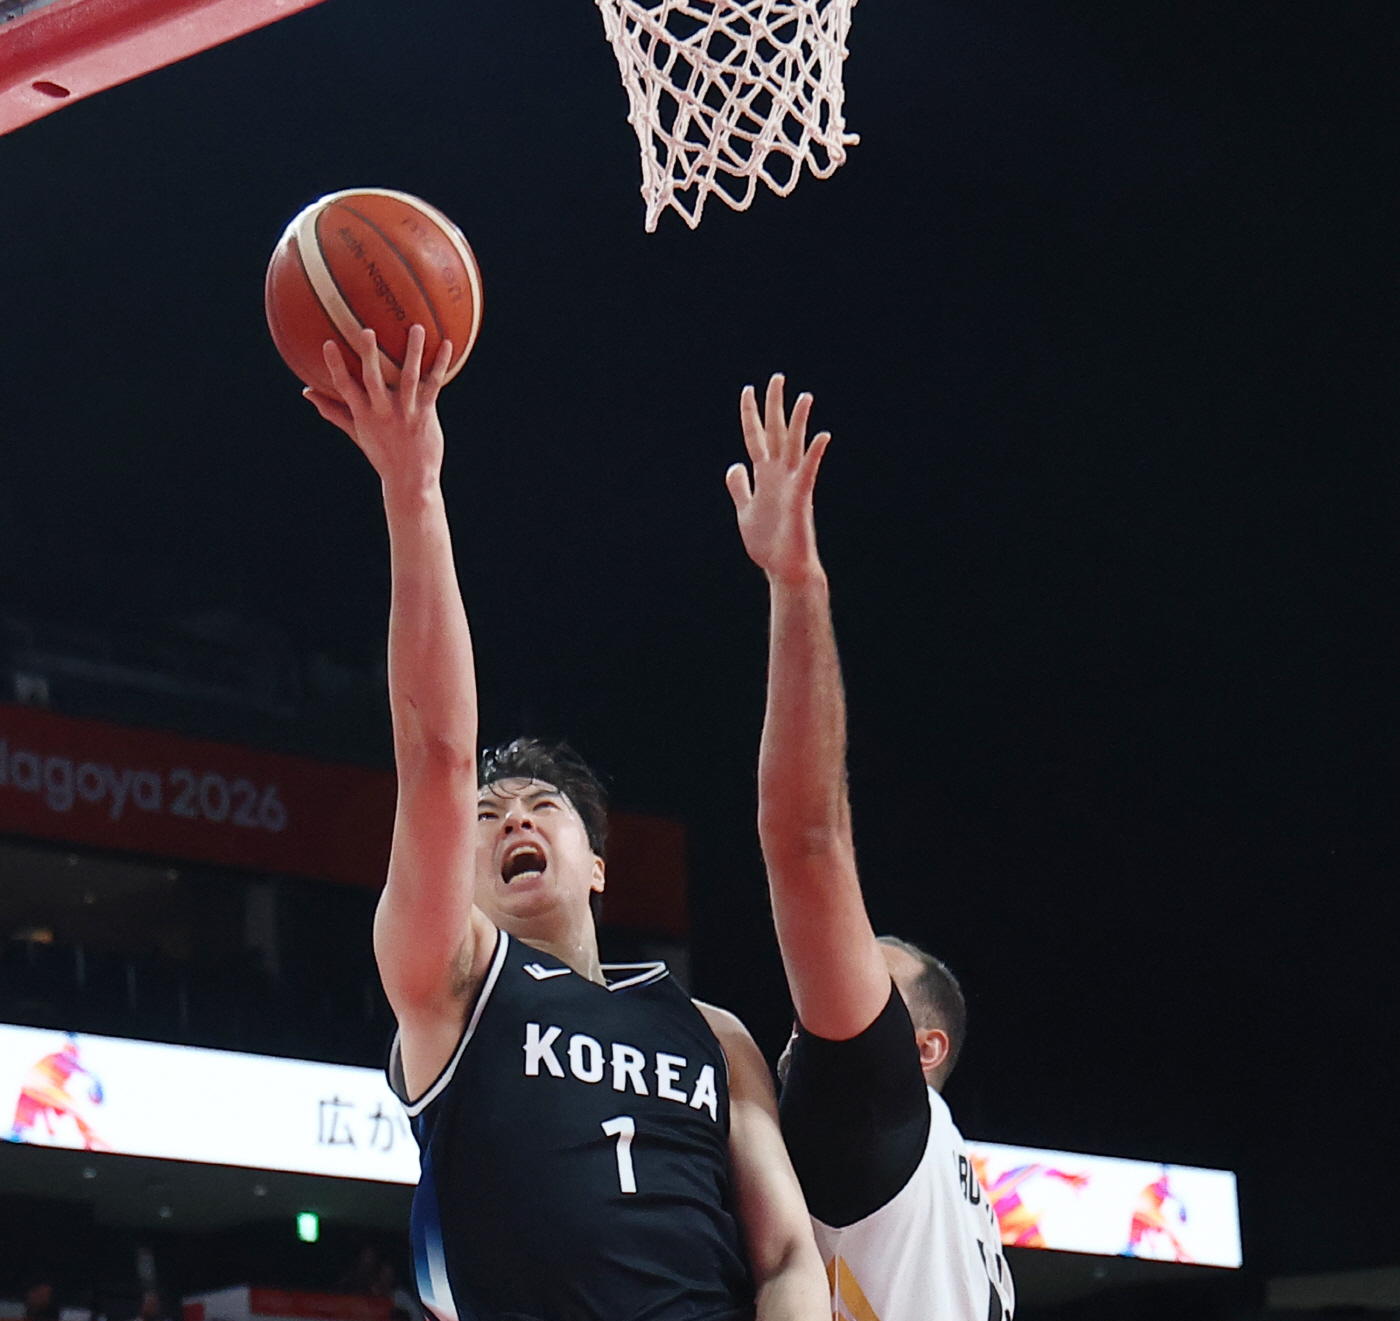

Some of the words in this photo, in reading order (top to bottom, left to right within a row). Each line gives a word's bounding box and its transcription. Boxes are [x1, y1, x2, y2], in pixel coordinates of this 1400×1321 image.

[169, 767, 288, 832] 2026
[523, 1022, 719, 1122] KOREA
[601, 1116, 637, 1194] 1
